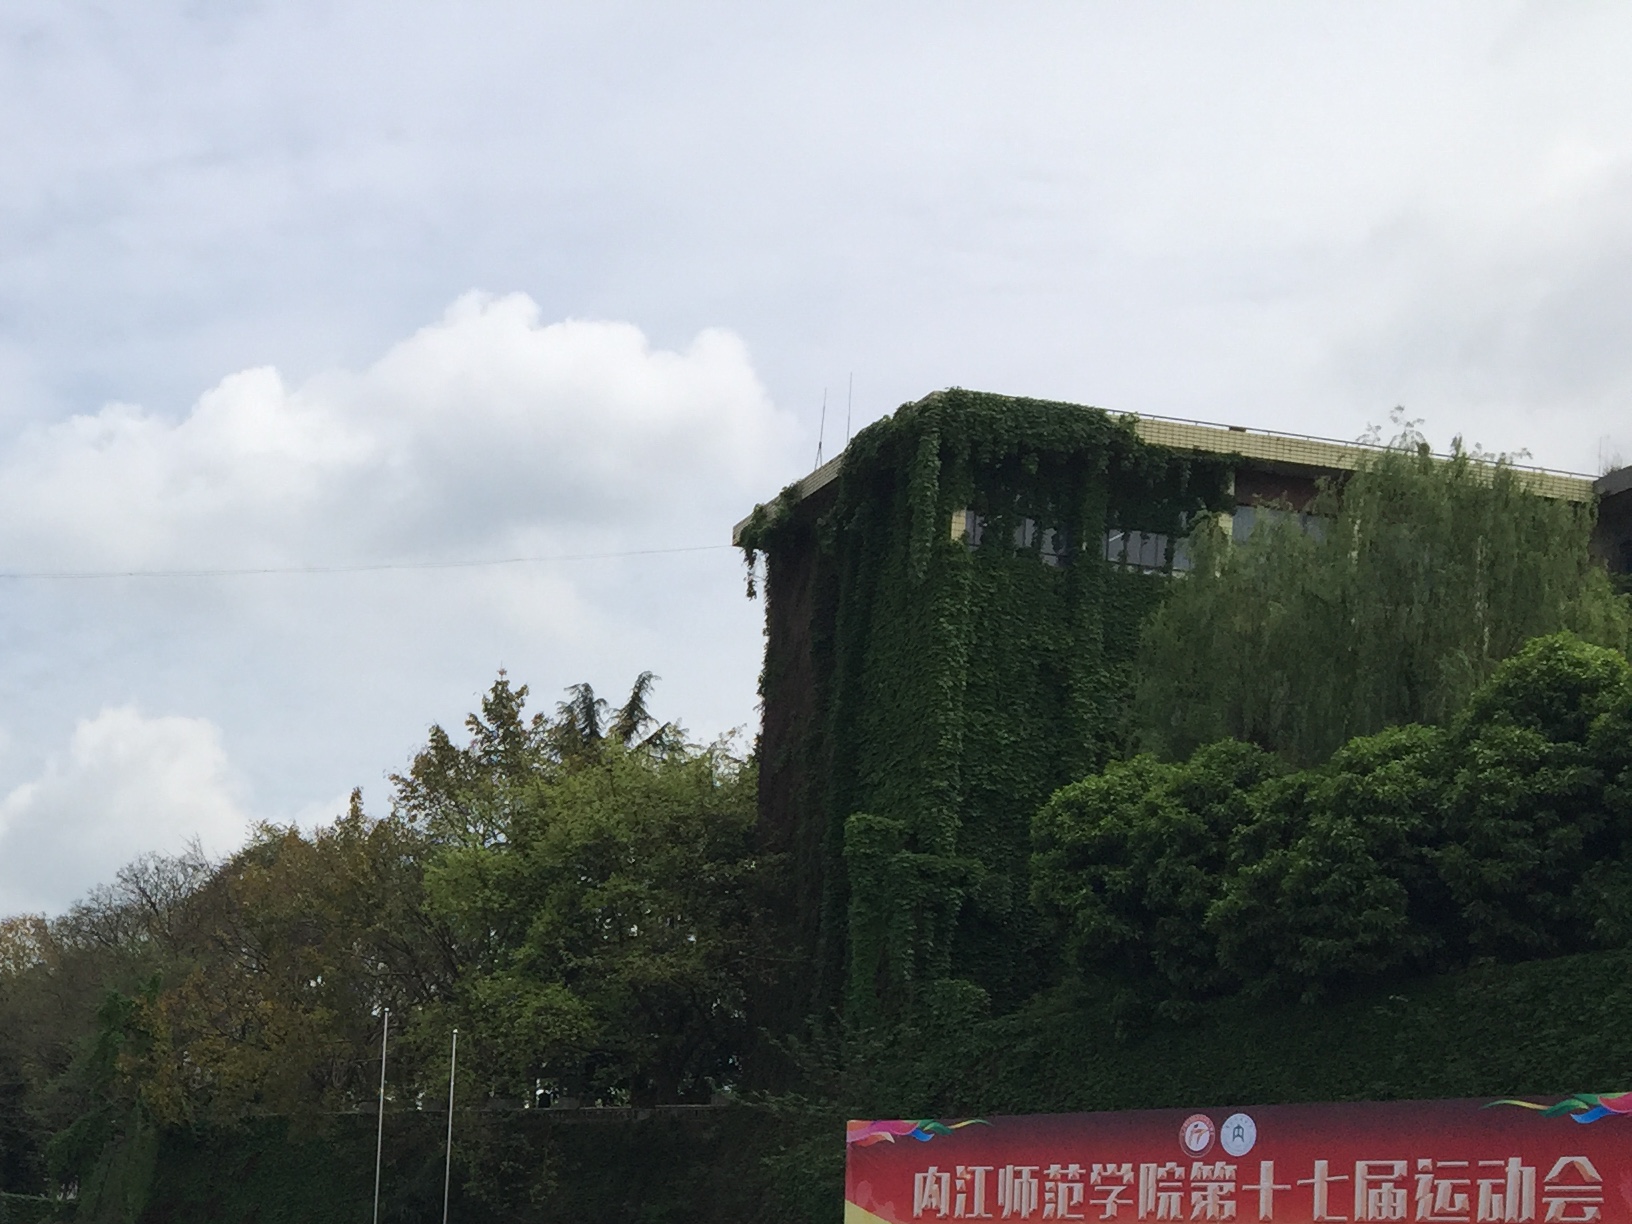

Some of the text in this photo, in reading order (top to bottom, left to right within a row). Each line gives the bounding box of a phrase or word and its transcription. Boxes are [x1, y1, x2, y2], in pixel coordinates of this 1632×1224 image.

[912, 1156, 1605, 1224] 内江师范学院第十七届运动会
